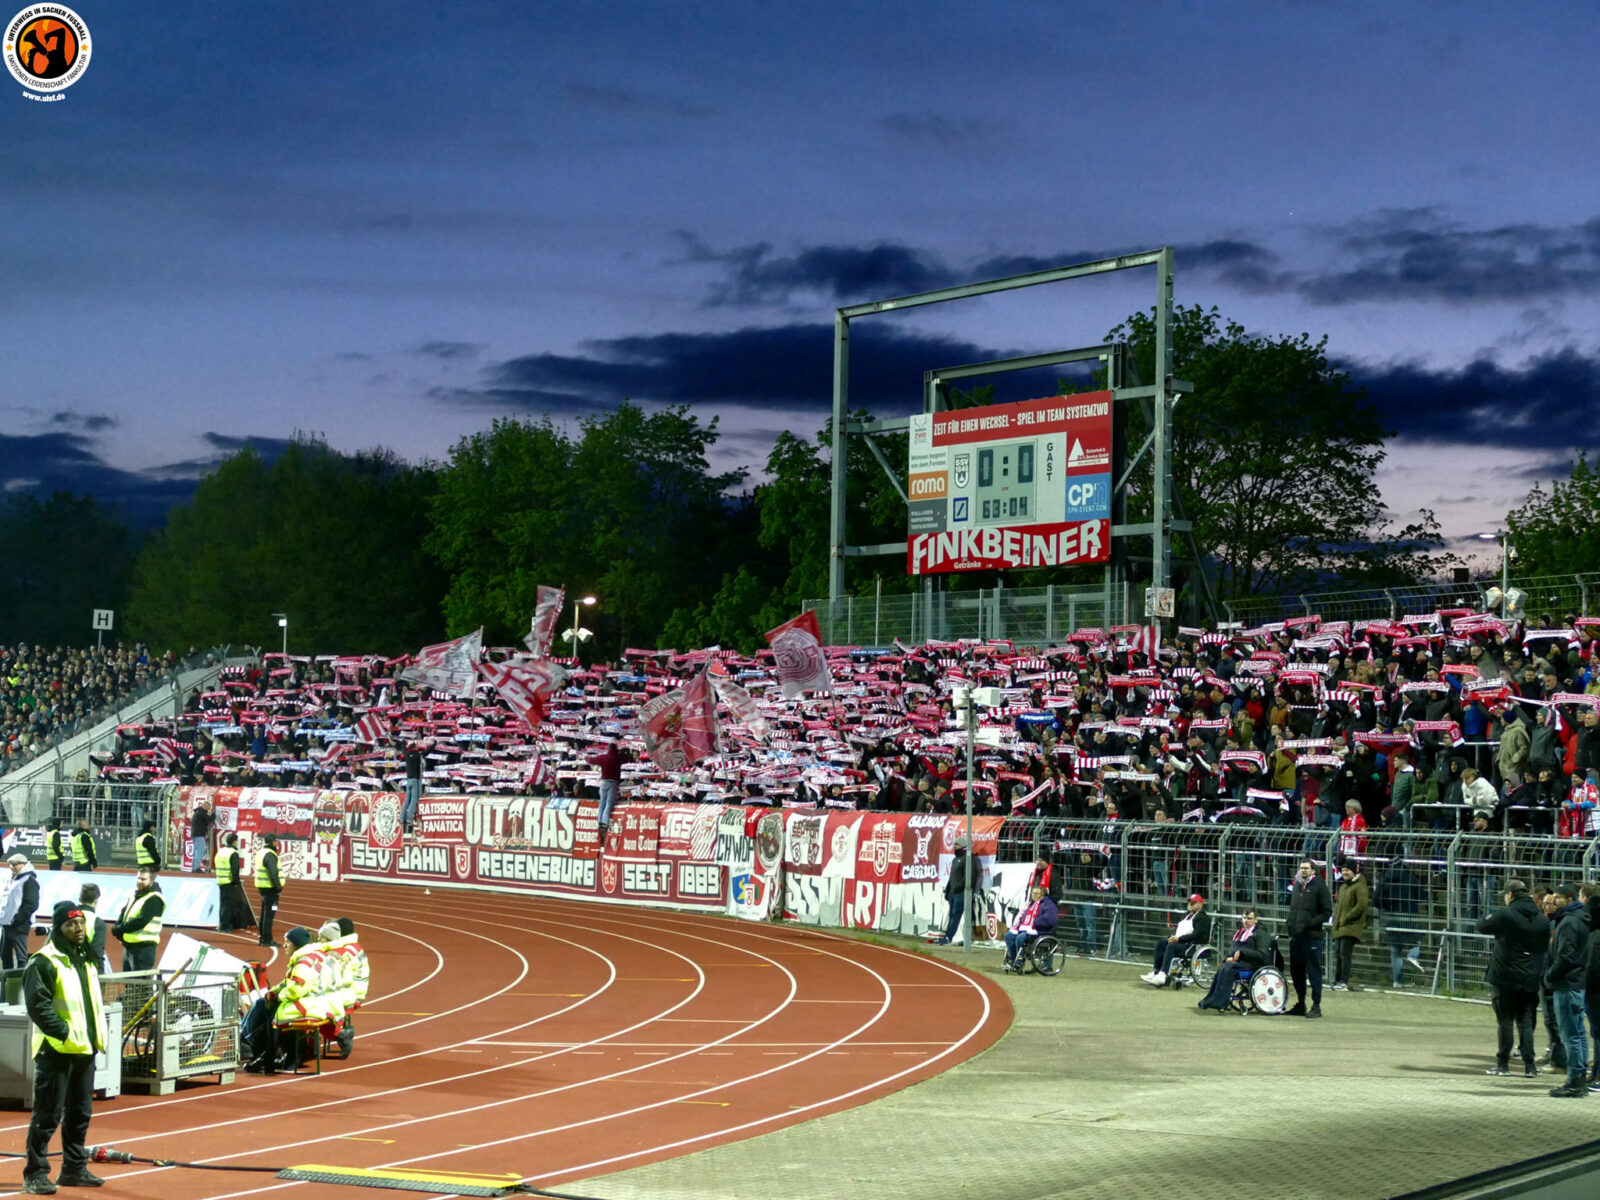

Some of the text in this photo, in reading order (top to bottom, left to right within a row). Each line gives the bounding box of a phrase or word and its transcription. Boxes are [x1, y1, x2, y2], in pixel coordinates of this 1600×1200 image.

[934, 423, 947, 436] ZEIT
[948, 419, 960, 435] FÜR
[961, 418, 979, 432] EINEN
[980, 414, 1010, 430] WECHSEL
[1017, 411, 1035, 426] SPIEL
[1036, 410, 1045, 423] IM
[1047, 408, 1065, 422] TEAM
[1066, 402, 1109, 420] SYSTEMZWO
[911, 477, 945, 496] roma
[912, 519, 1102, 575] FINKBEINER
[953, 560, 982, 570] Getränke
[418, 802, 465, 815] RATISBONA
[422, 820, 465, 833] FANATICA
[465, 797, 578, 850] ULTRAS
[352, 842, 721, 896] SSV JAHN REGENSBURG SEIT 1889
